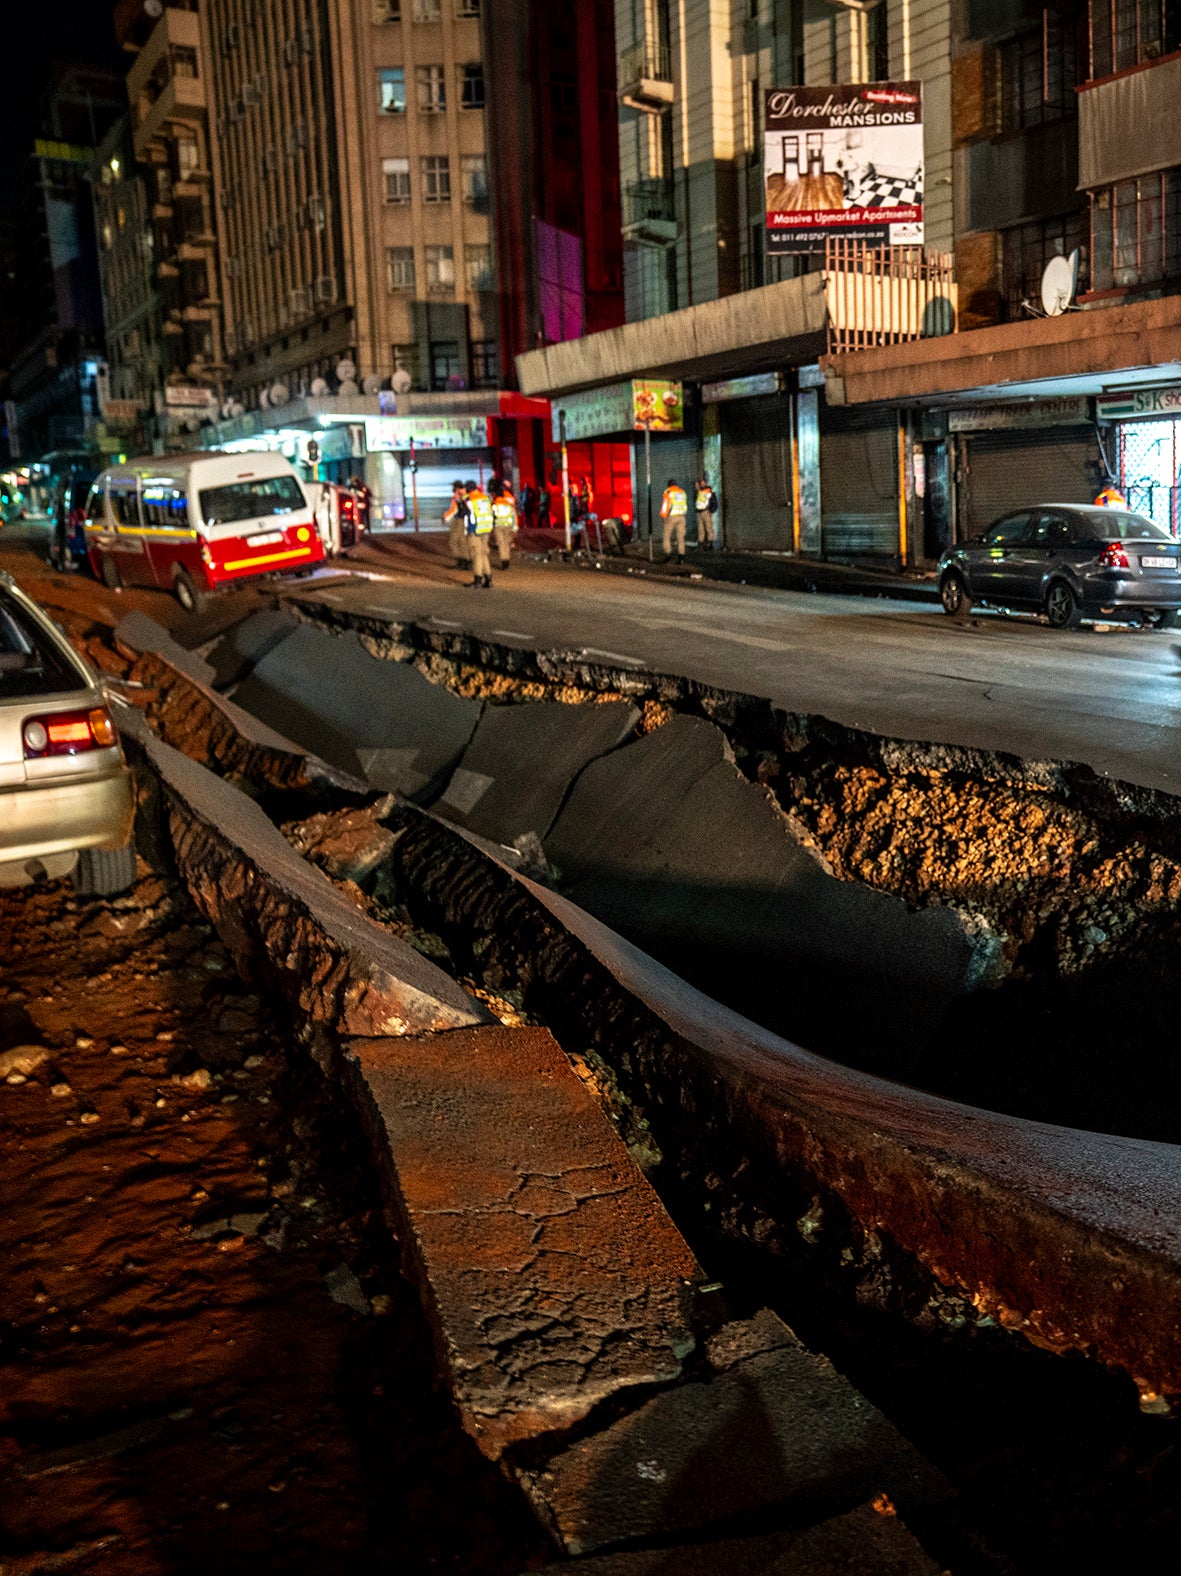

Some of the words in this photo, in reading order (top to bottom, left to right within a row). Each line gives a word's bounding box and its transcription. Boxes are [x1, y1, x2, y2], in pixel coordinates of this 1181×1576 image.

[768, 92, 875, 119] Dorchester
[829, 112, 916, 127] MANSIONS
[773, 213, 812, 224] Massive
[814, 211, 860, 224] Upmarket
[862, 209, 917, 222] Apartments
